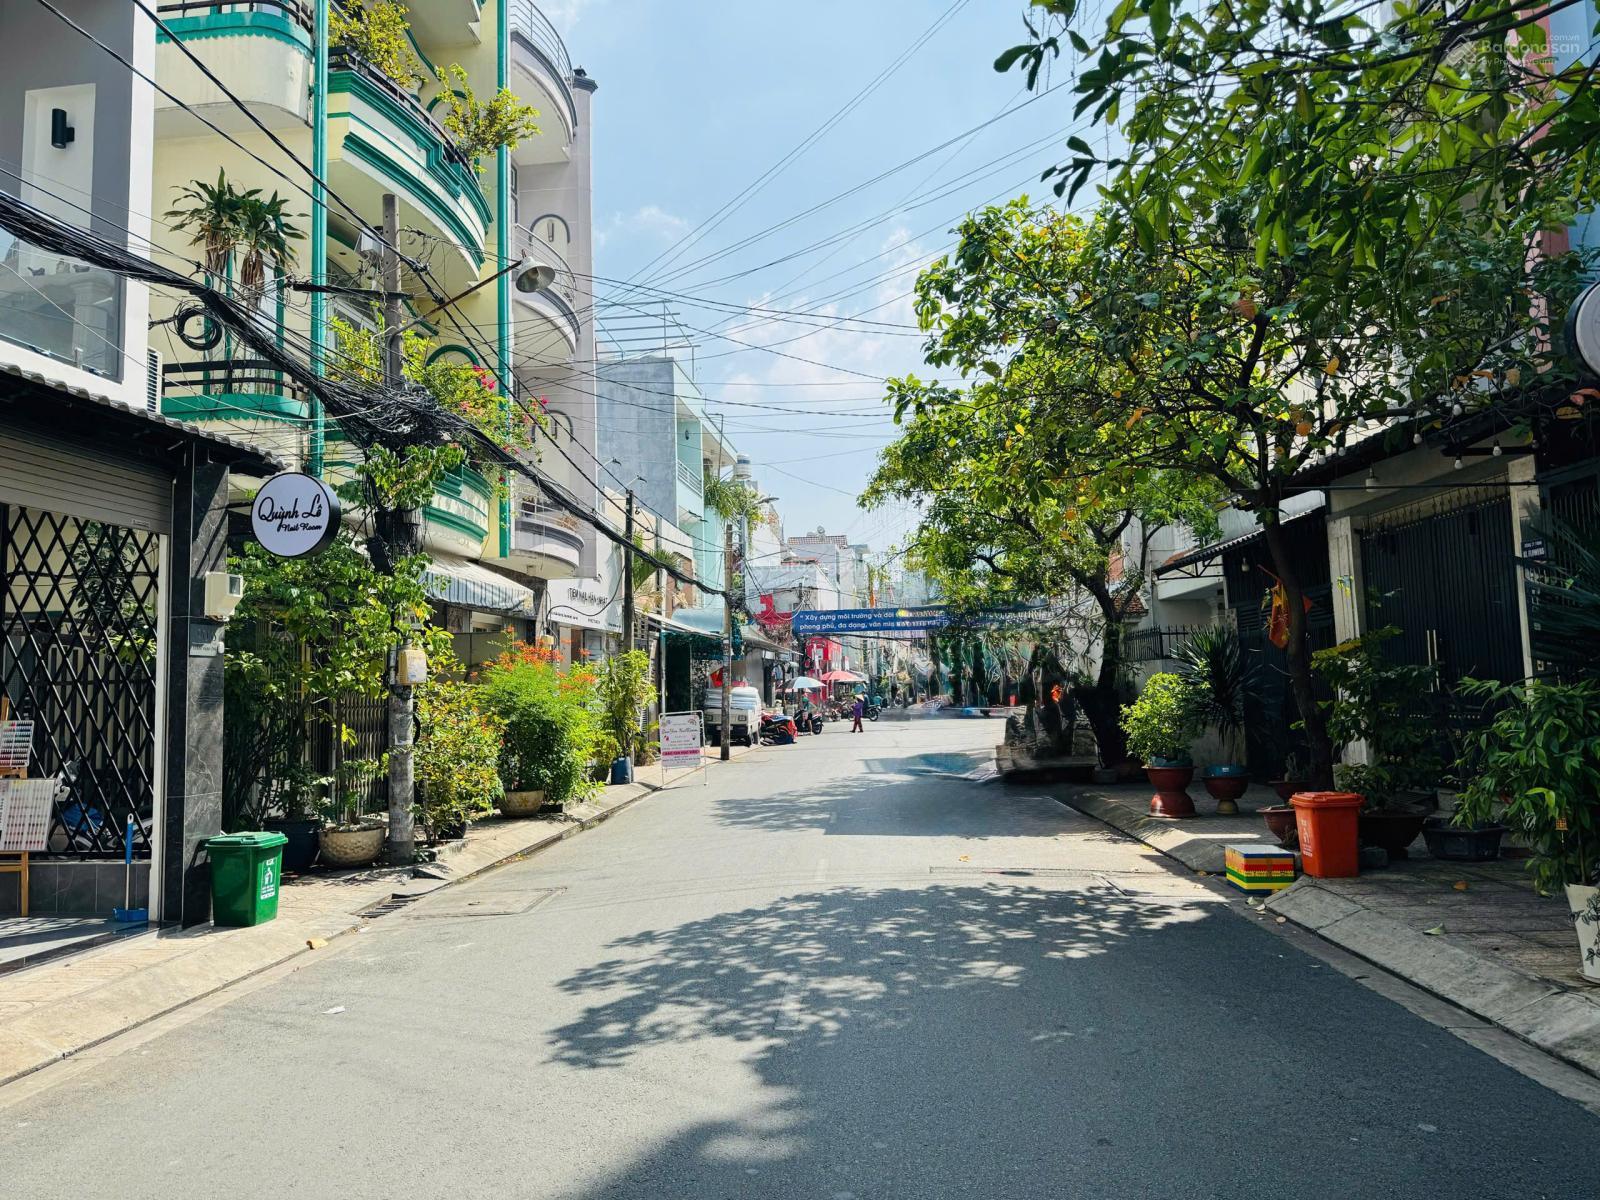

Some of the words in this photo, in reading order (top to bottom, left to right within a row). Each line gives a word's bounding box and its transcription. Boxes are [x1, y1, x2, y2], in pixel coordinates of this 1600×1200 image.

[258, 496, 299, 532] Quỳnh
[281, 523, 299, 532] Nail
[300, 522, 322, 531] Room
